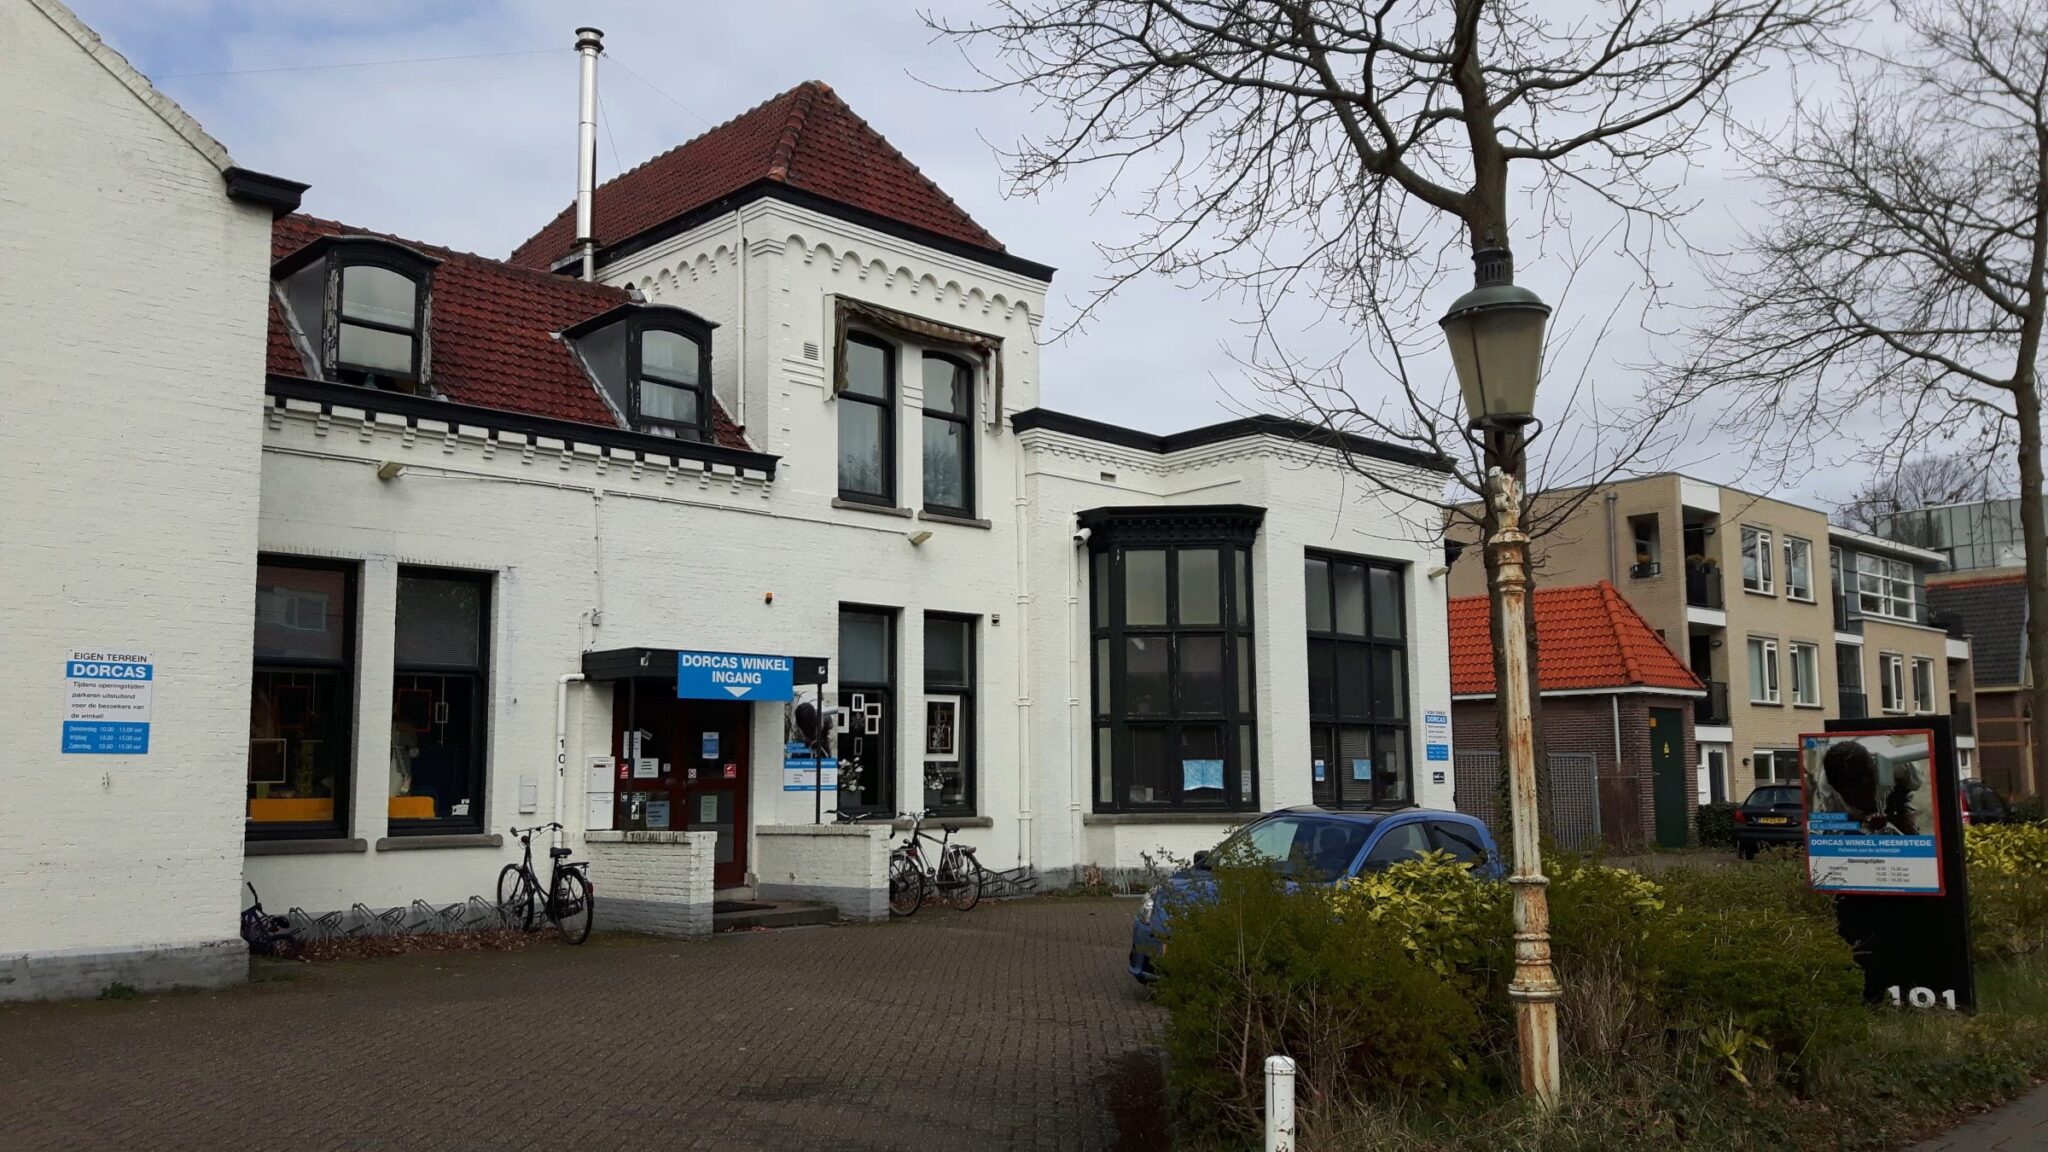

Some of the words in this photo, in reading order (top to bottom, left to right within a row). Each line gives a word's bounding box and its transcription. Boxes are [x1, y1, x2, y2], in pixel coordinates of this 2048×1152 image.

[74, 652, 104, 661] EIGEN
[107, 653, 147, 663] TERREIN
[682, 654, 738, 669] DORCAS
[741, 657, 790, 671] WINKEL
[73, 663, 146, 678] DORCAS
[712, 670, 762, 684] INGANG
[558, 738, 566, 777] 101
[1878, 839, 1932, 847] HEEMSTEDE
[1887, 985, 1956, 1010] 101
